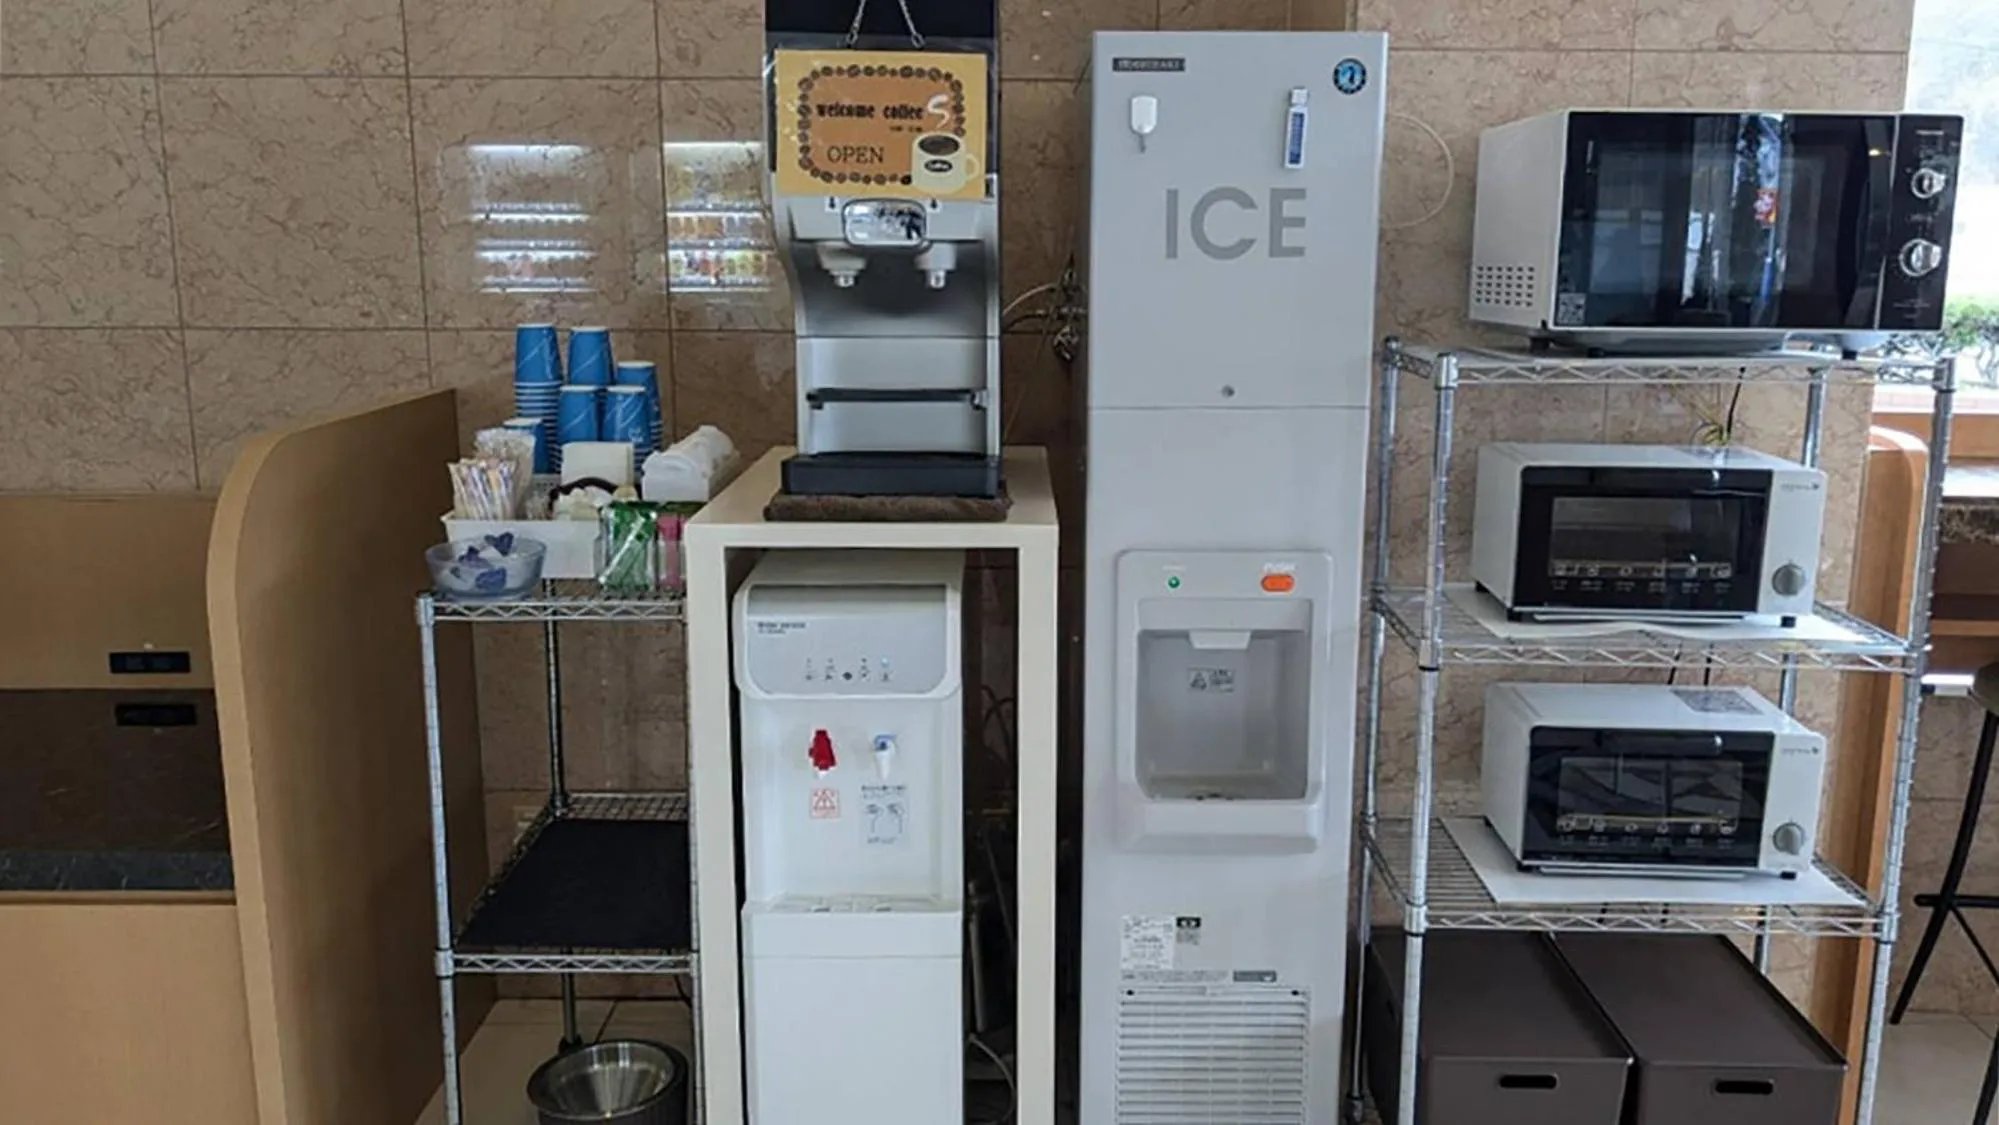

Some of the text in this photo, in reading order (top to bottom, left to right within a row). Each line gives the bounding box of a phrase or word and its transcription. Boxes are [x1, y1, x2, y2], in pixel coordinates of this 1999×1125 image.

[816, 102, 924, 120] welcome coffee
[827, 145, 884, 164] OPEN
[1165, 186, 1307, 260] ICE
